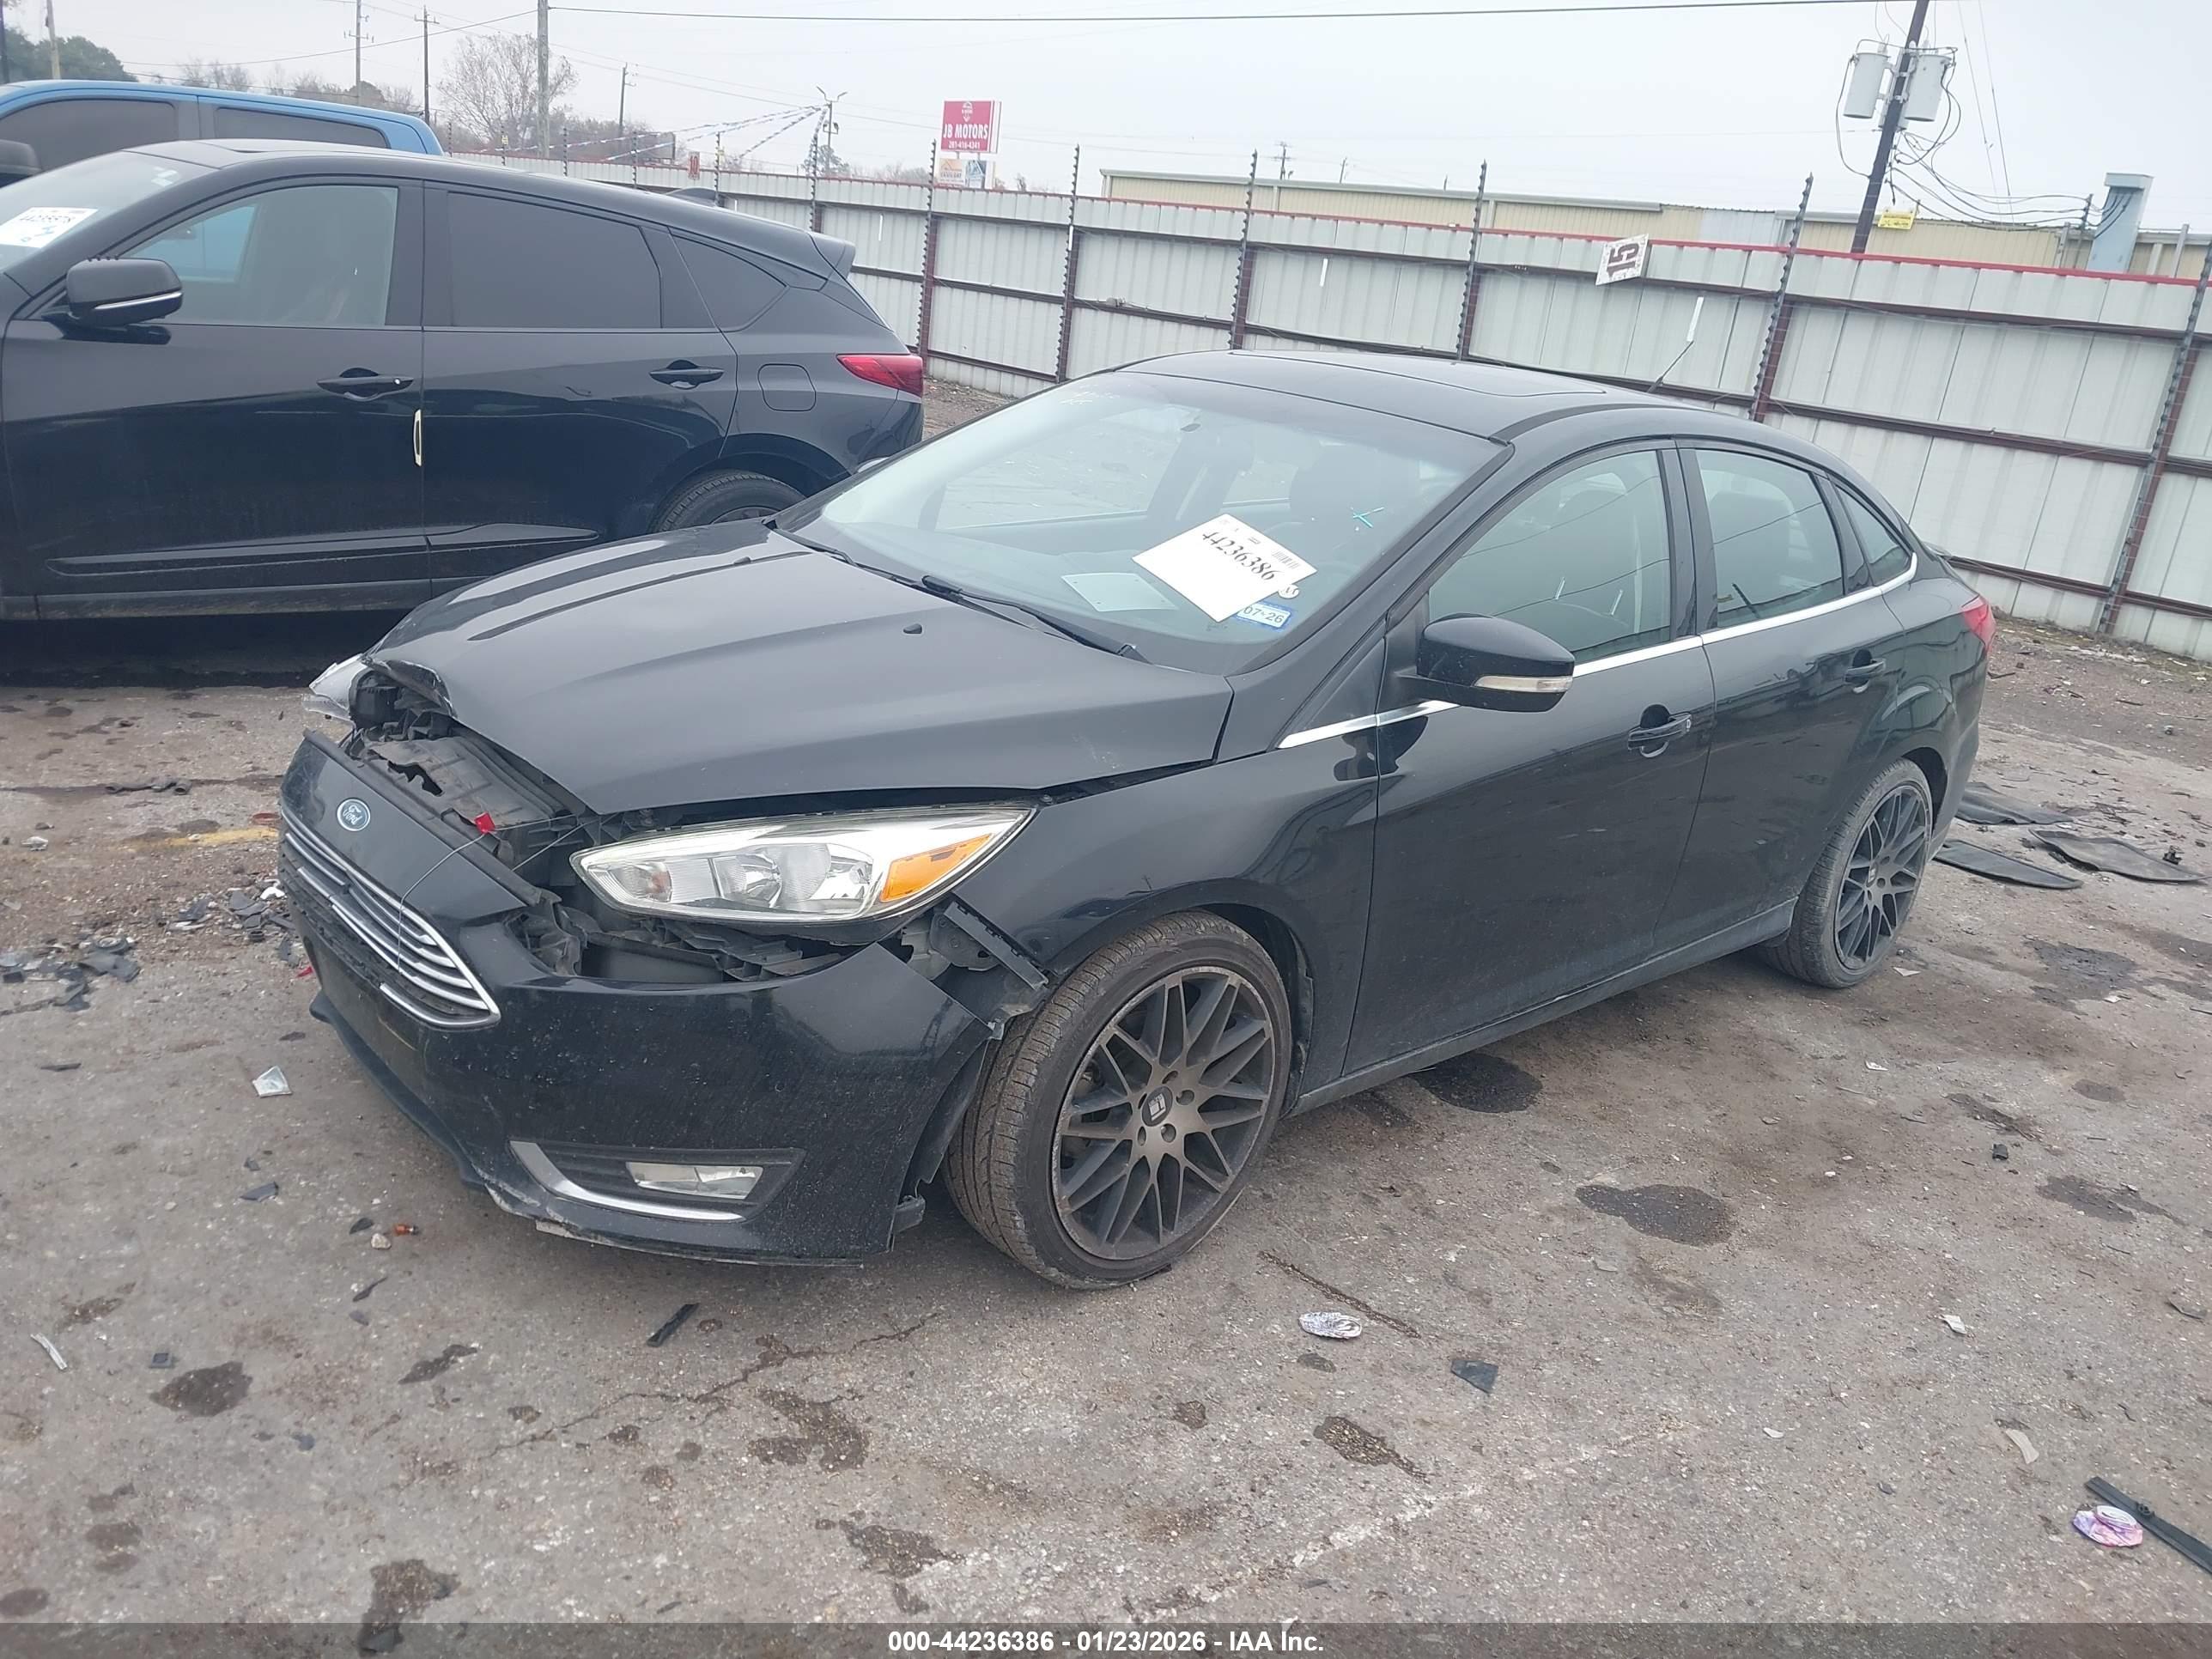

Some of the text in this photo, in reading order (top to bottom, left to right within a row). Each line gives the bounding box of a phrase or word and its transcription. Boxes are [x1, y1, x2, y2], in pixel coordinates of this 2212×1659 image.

[943, 124, 988, 139] JB MOTORS
[1202, 532, 1285, 580] 44236386
[1243, 605, 1285, 623] 07 26
[342, 804, 363, 825] Ford
